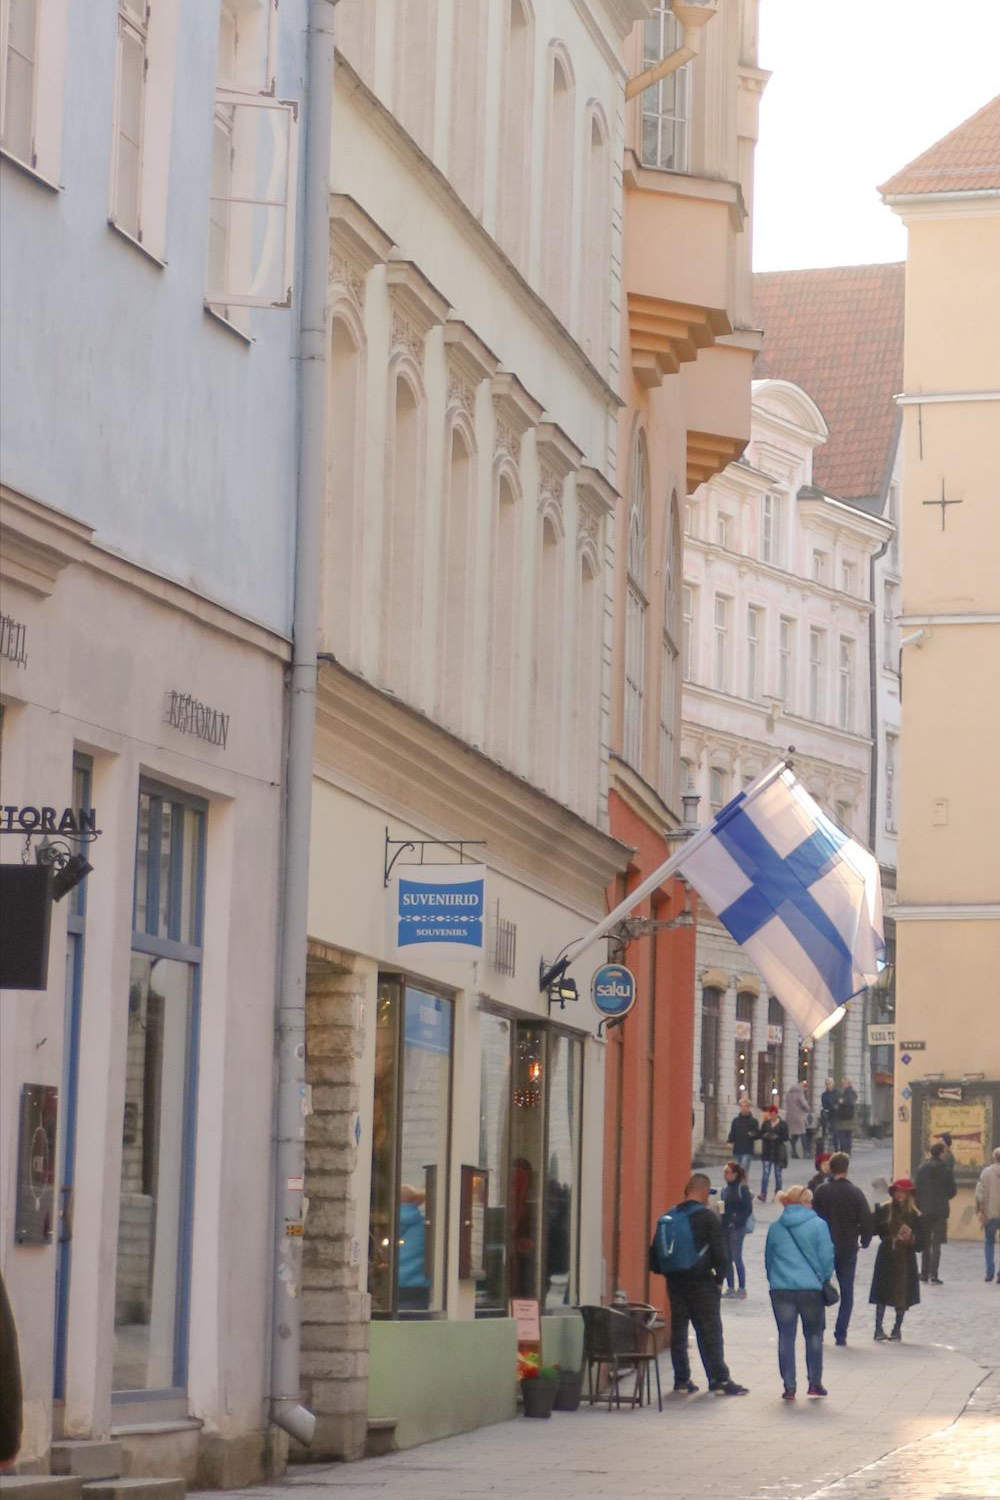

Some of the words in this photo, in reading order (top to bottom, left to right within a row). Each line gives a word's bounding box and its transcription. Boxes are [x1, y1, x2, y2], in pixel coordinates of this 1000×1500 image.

[0, 806, 96, 831] TORAN
[402, 893, 479, 906] SUVENIIRID
[416, 928, 468, 937] SOUVENIRS
[596, 982, 631, 997] saku
